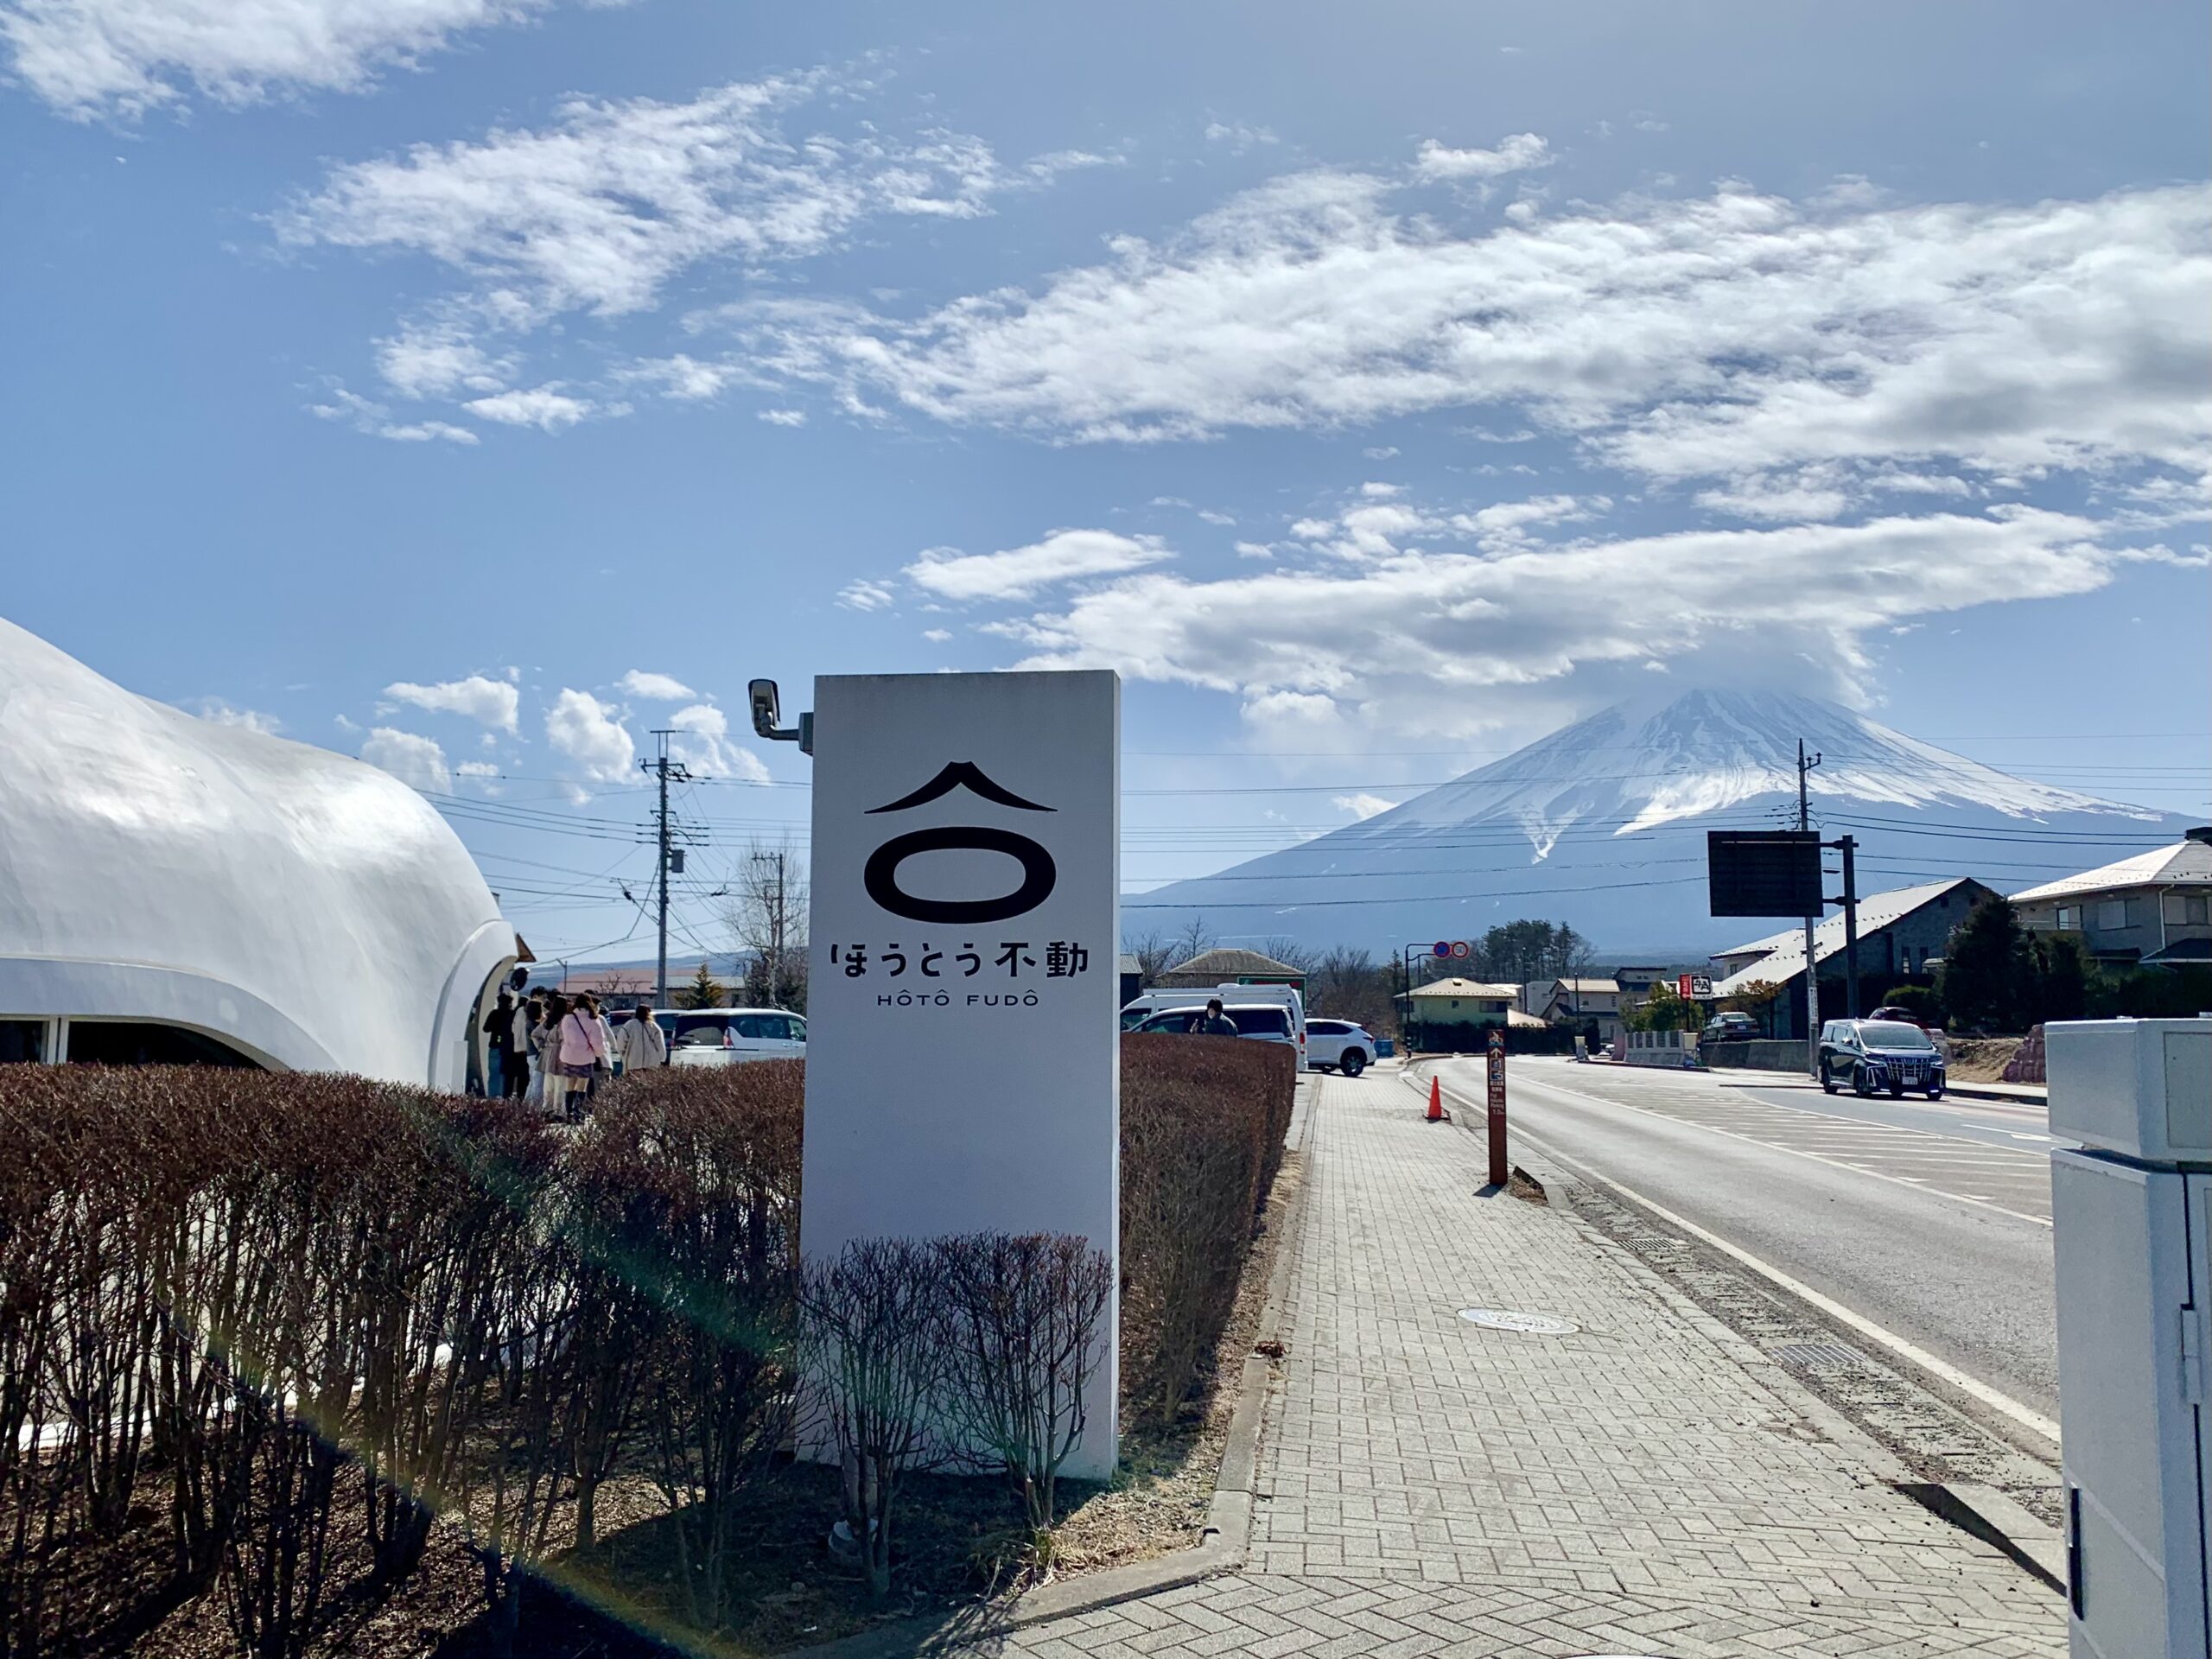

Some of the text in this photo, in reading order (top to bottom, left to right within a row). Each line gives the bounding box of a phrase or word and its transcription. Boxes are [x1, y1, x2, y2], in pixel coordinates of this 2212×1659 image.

[830, 940, 1088, 978] ほうとう不動
[877, 988, 1039, 1007] HÔTÔ FUDÔ
